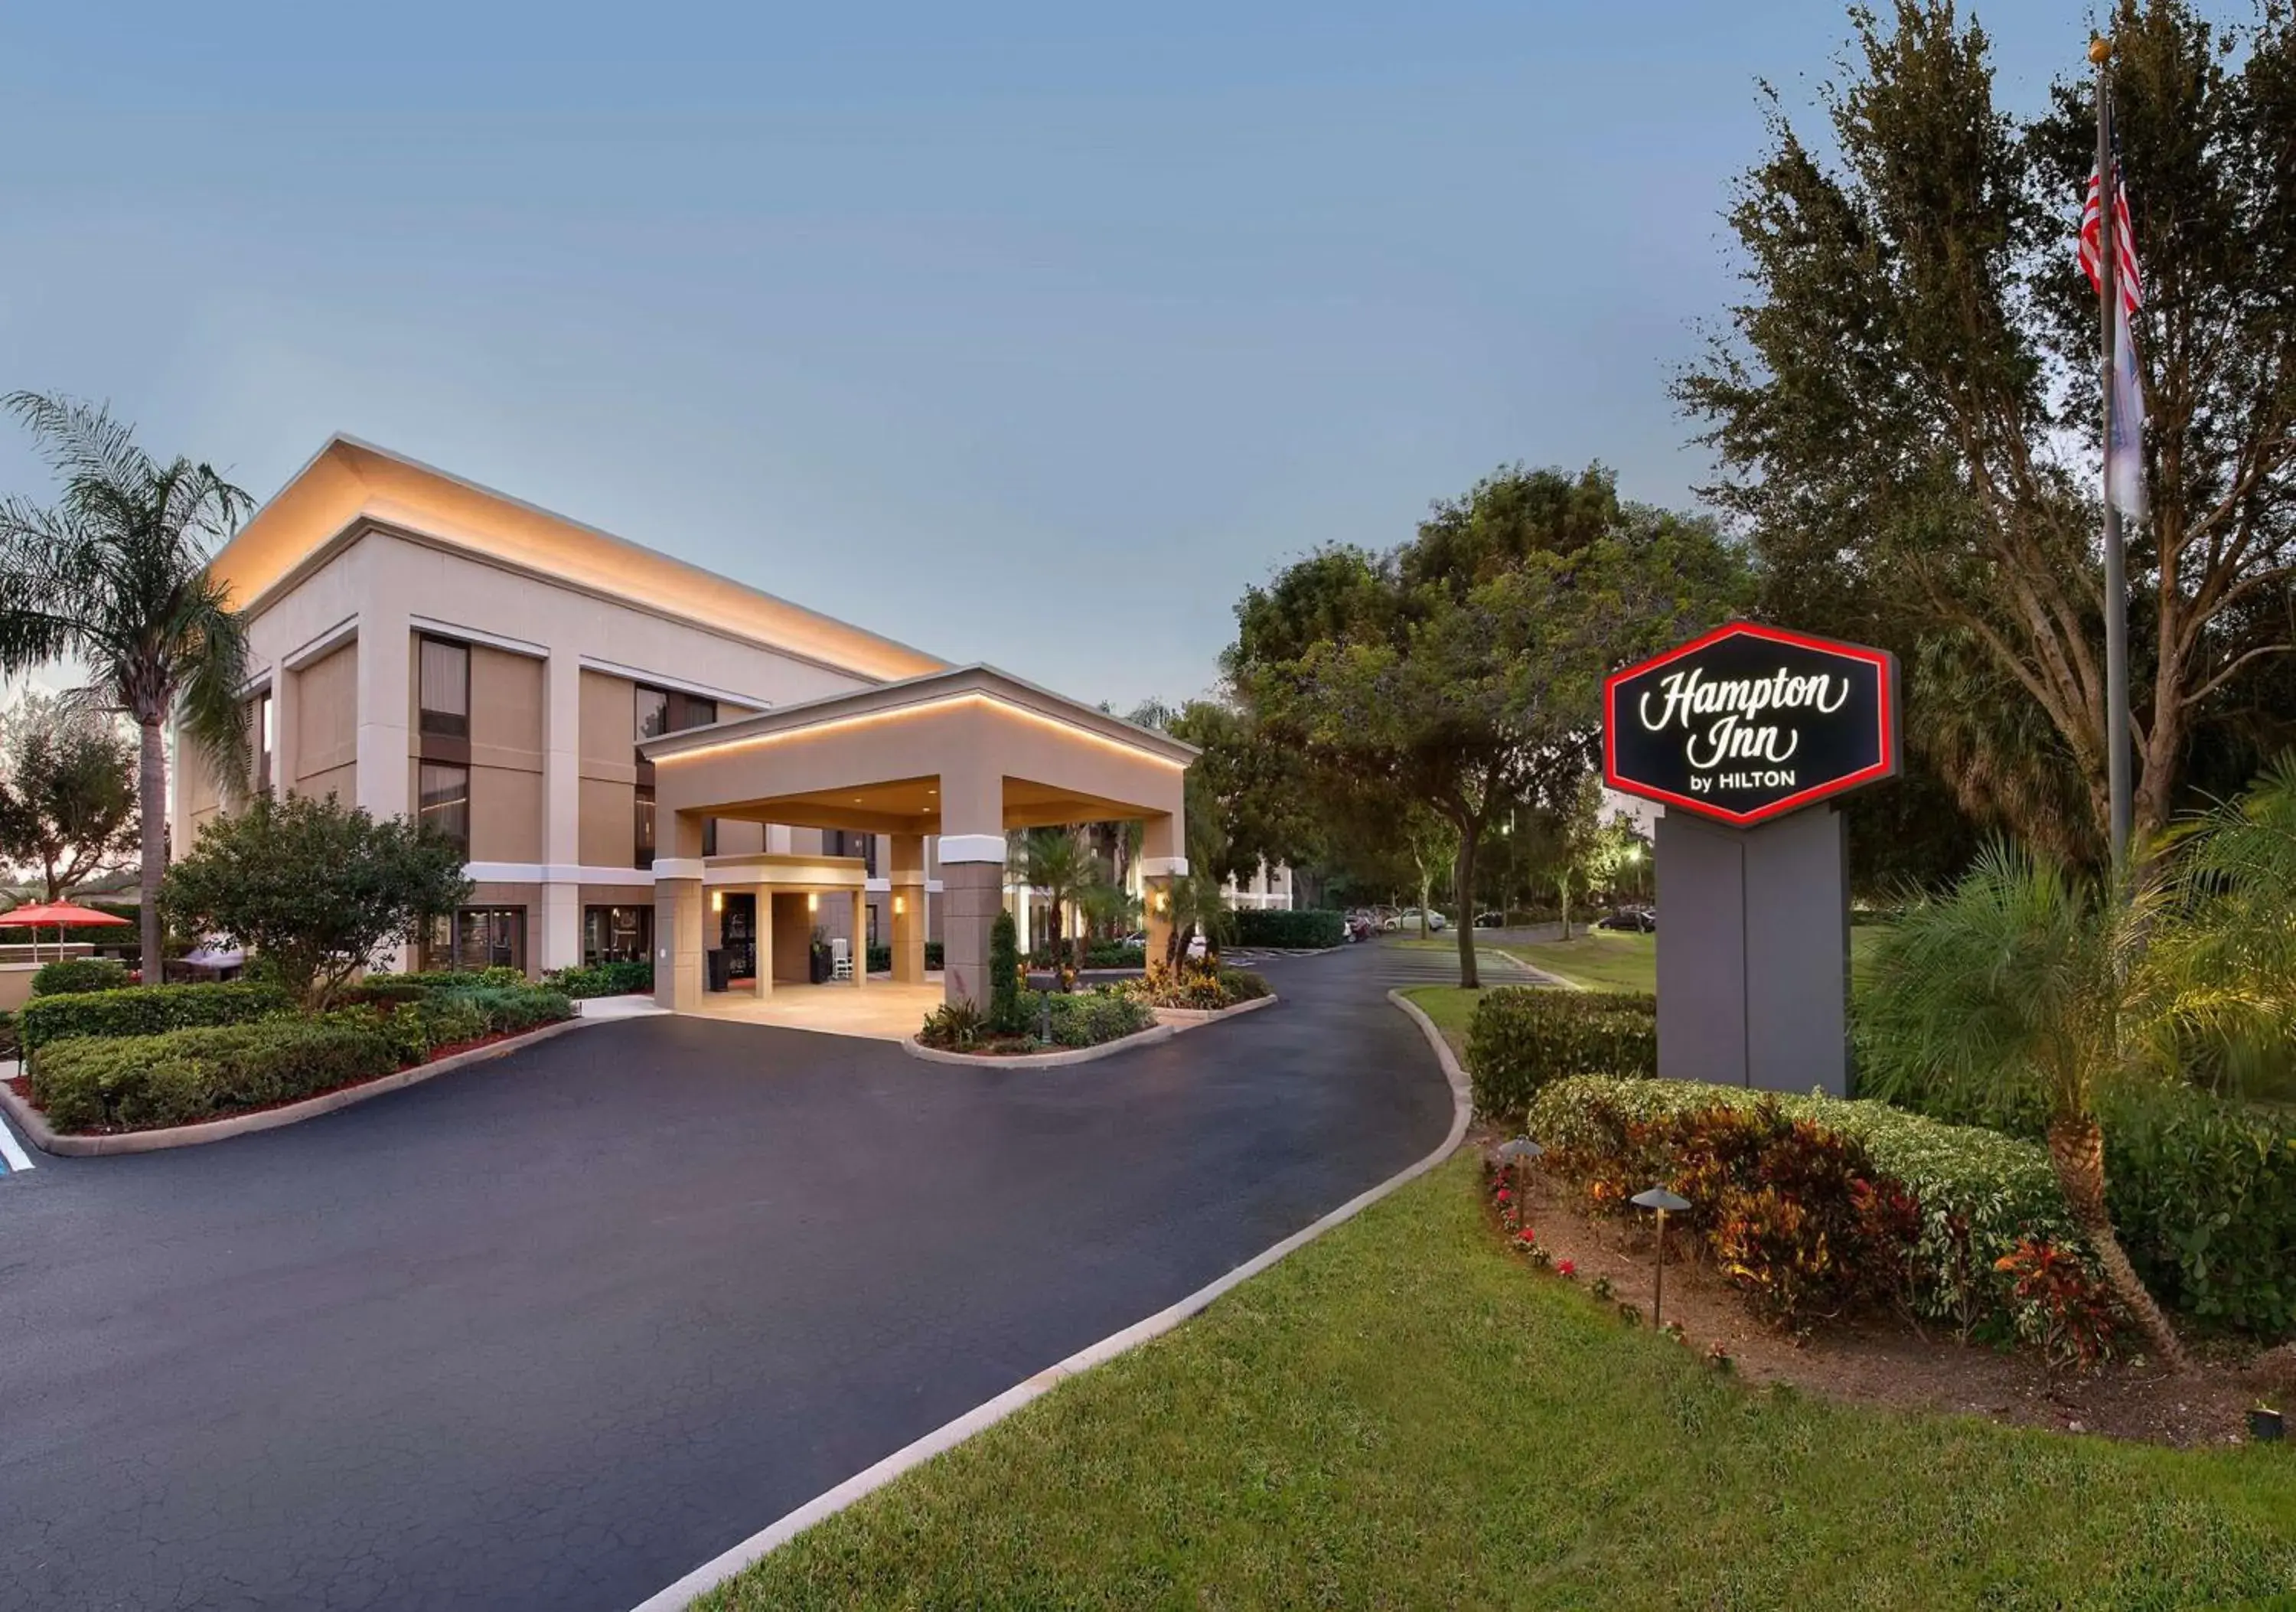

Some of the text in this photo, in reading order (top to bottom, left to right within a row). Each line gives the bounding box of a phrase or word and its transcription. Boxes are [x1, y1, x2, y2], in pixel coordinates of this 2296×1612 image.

[1640, 667, 1849, 731] Hampton
[1686, 715, 1798, 768] Inn
[1690, 770, 1795, 793] by HILTON
